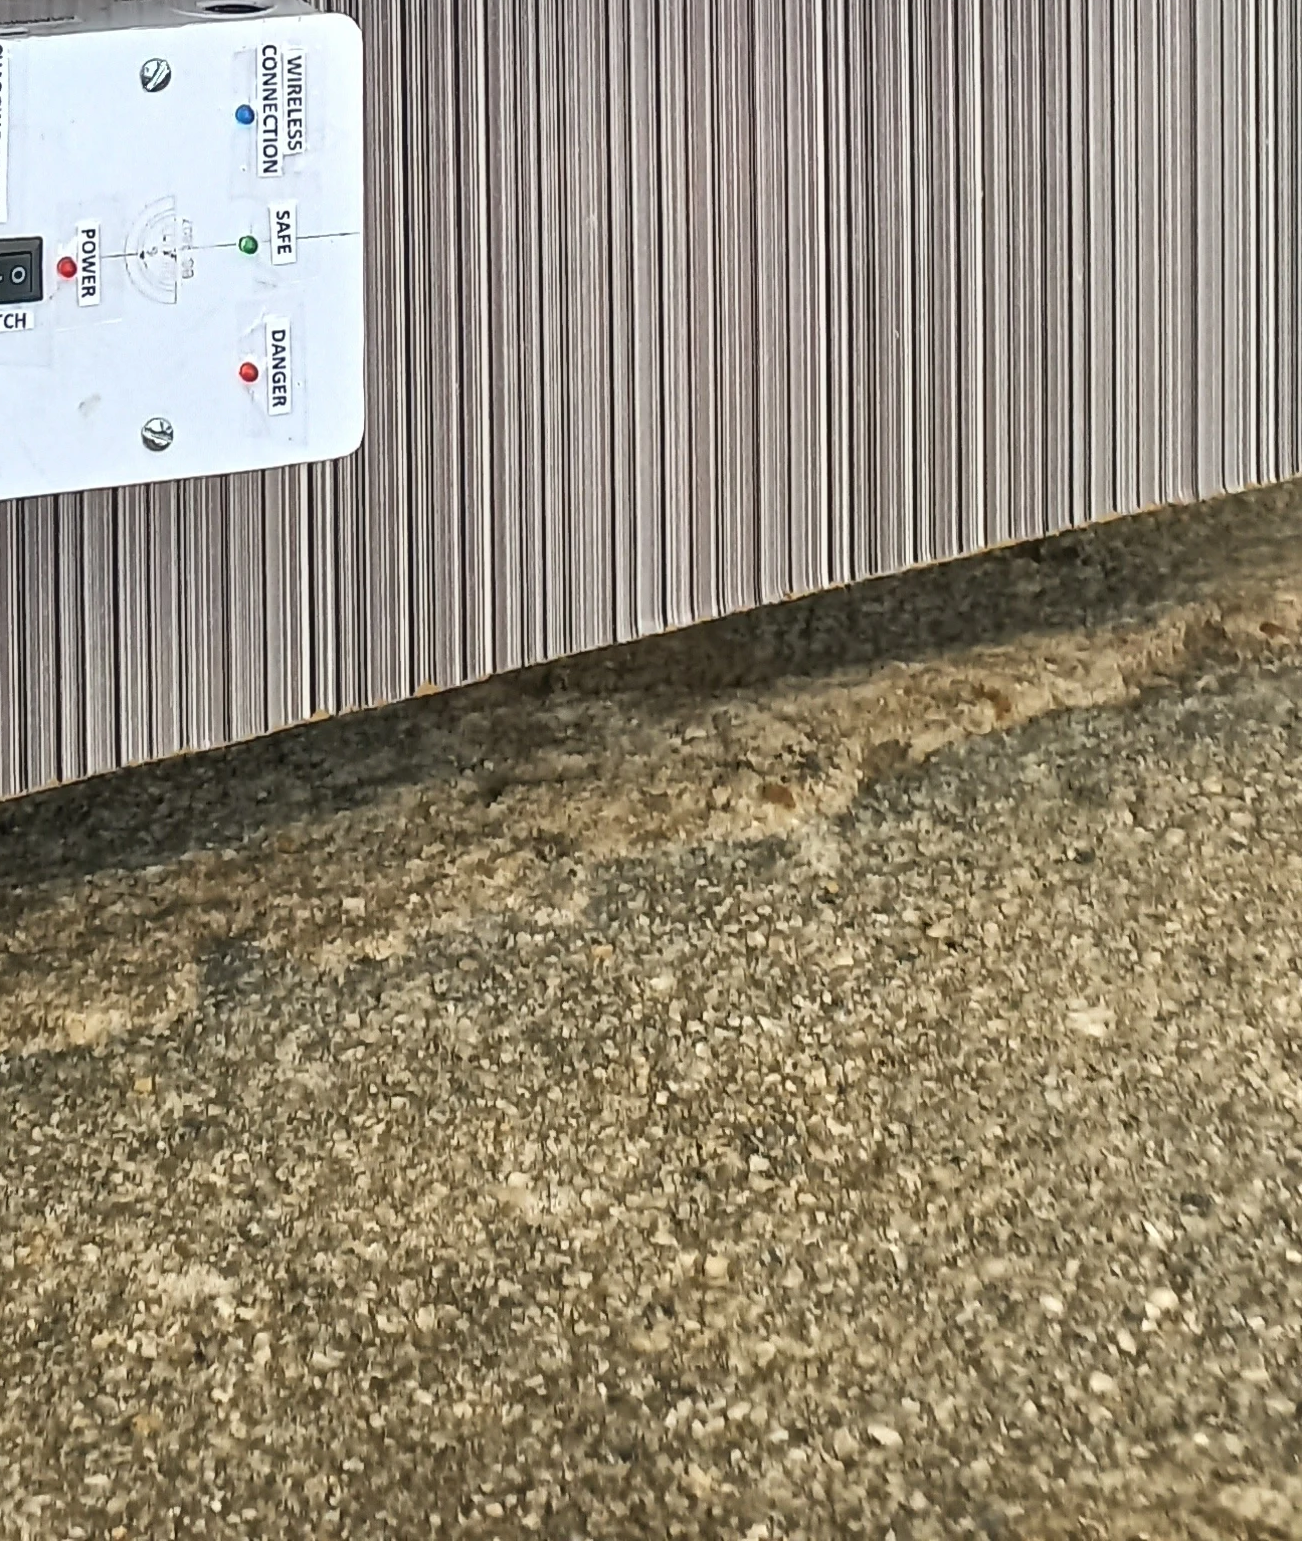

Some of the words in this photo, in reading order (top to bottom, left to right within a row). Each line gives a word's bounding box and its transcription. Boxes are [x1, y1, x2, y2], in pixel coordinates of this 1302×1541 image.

[261, 44, 278, 174] CONNECTION
[286, 54, 303, 152] WIRELESS
[80, 228, 96, 299] POWER
[276, 210, 293, 256] SAFE
[271, 329, 287, 407] DANGER
